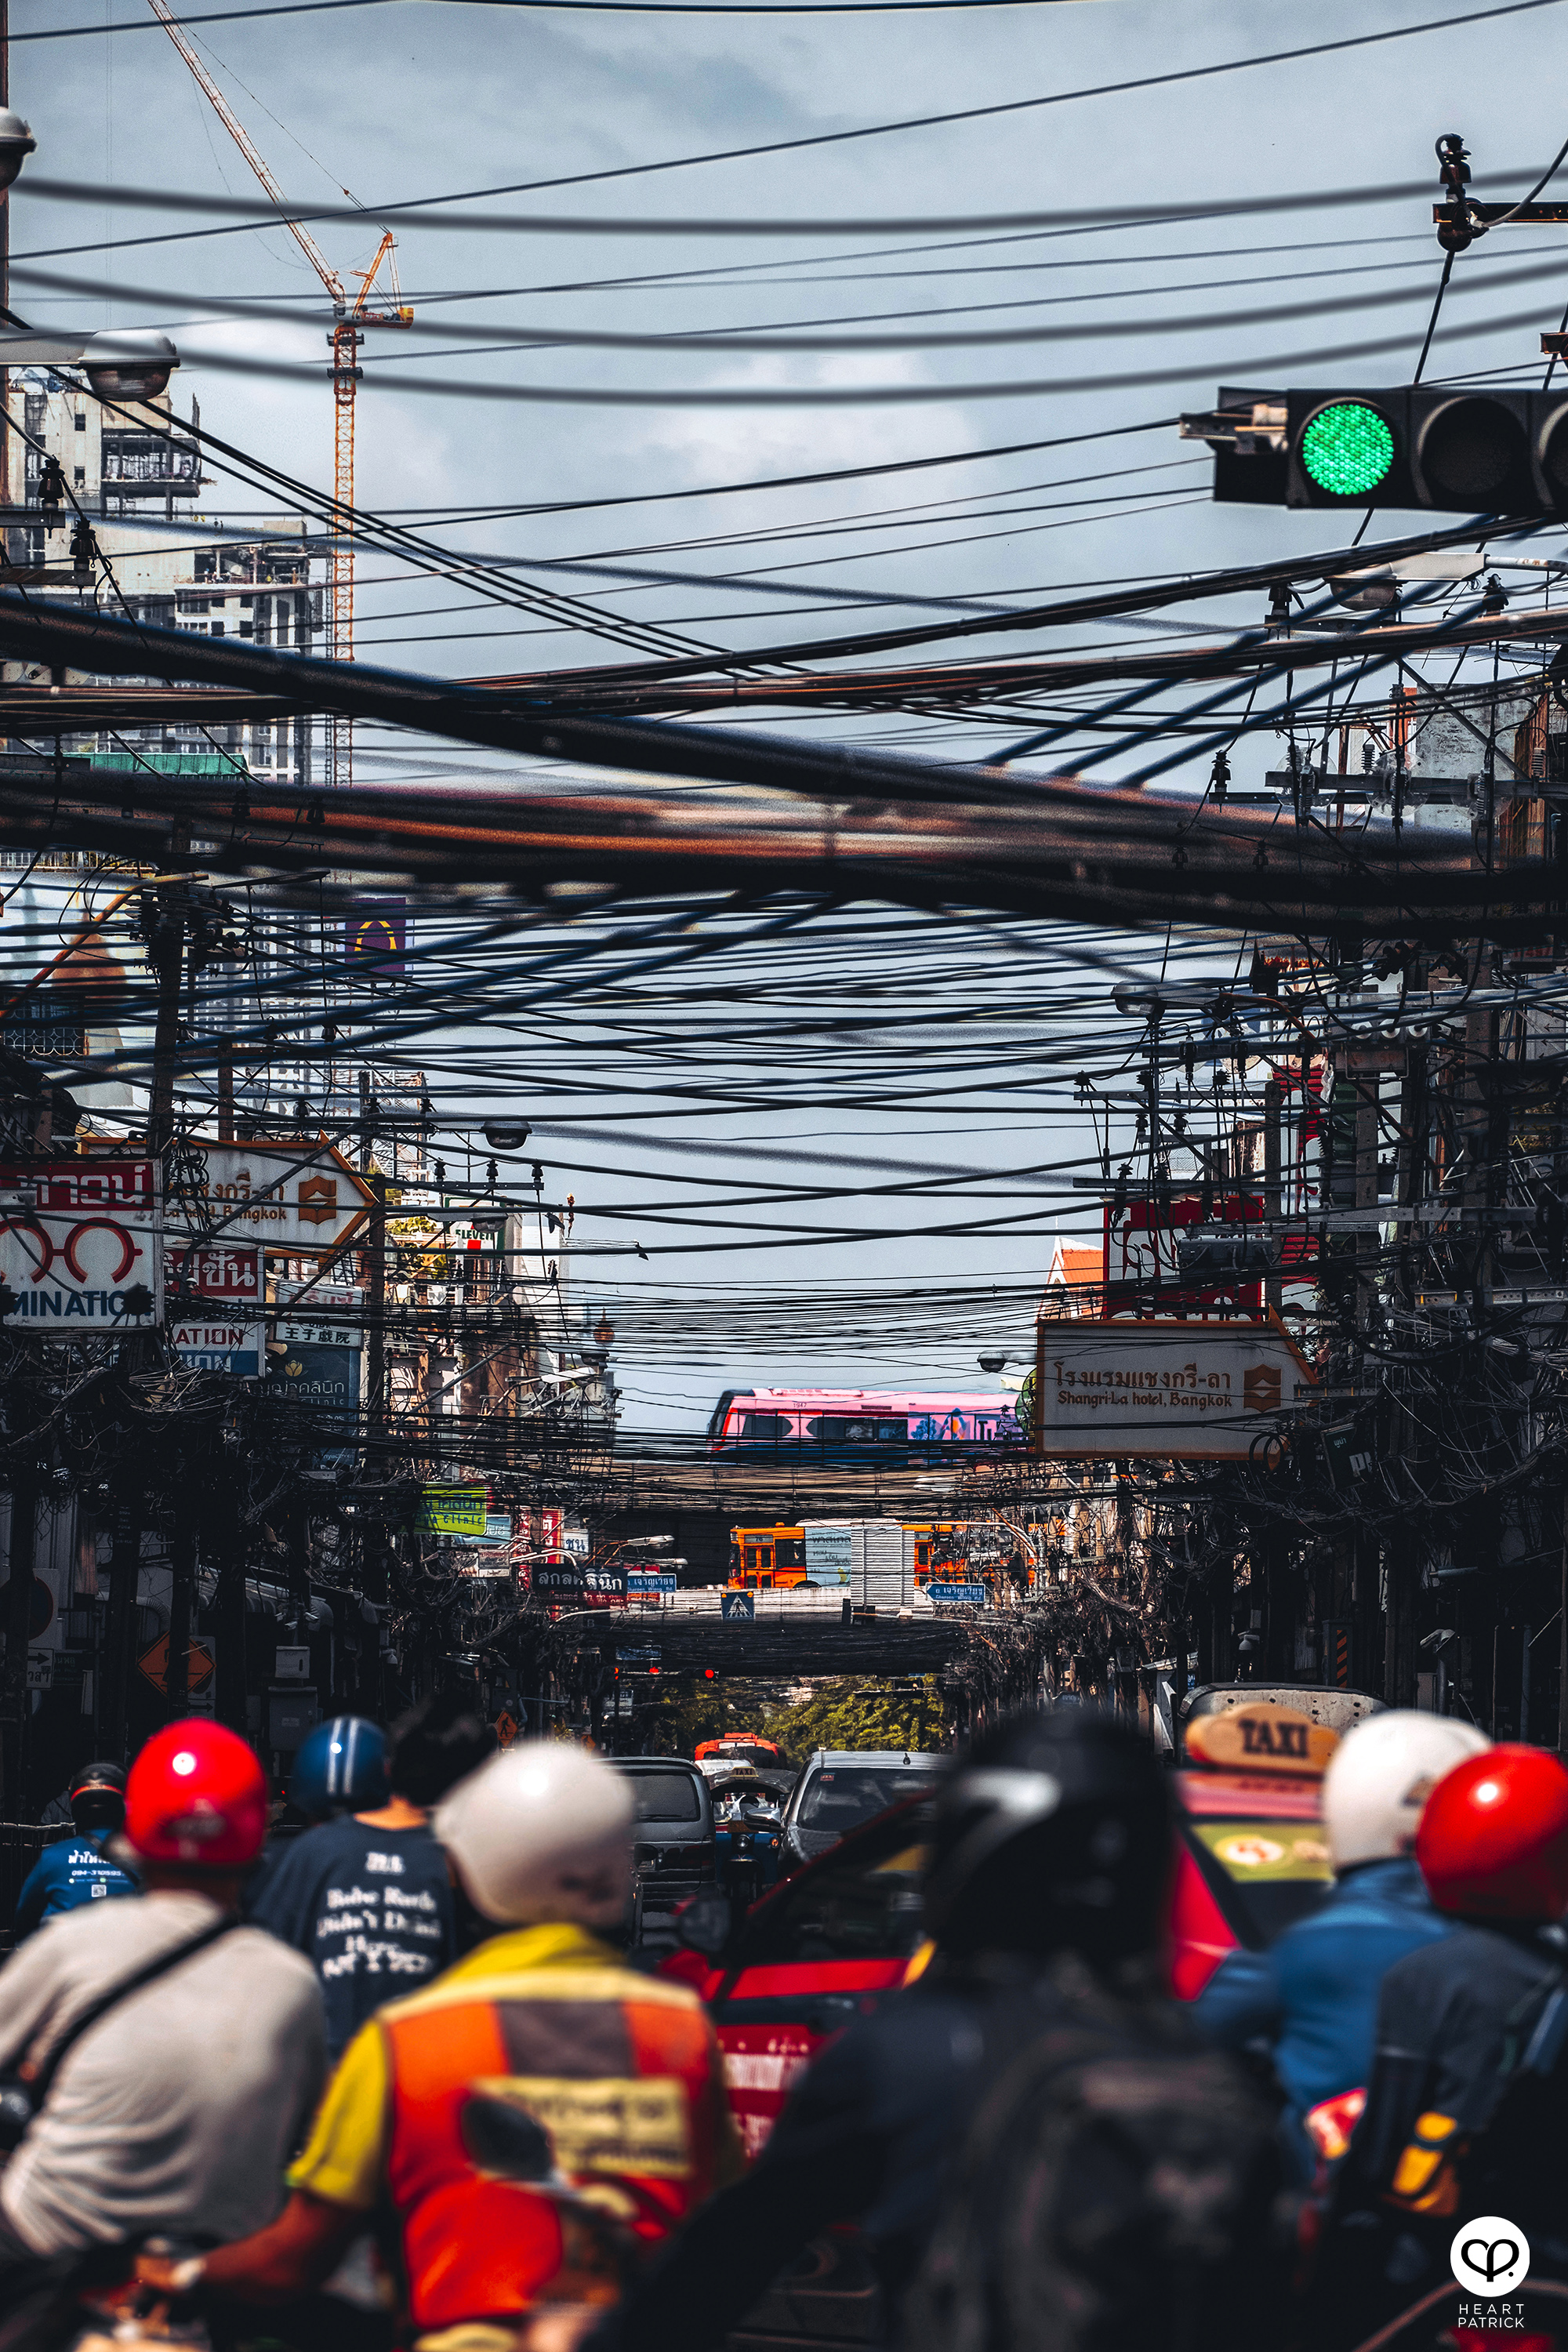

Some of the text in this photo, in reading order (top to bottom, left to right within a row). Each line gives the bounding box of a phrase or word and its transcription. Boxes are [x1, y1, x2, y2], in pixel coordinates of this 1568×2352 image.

[223, 1204, 287, 1225] Bngkok
[1054, 1361, 1231, 1388] โรงแรมแชงกรี-ลา
[1132, 1391, 1167, 1407] hotel,
[1169, 1391, 1233, 1410] Bangkok
[1238, 1717, 1309, 1759] TAXI
